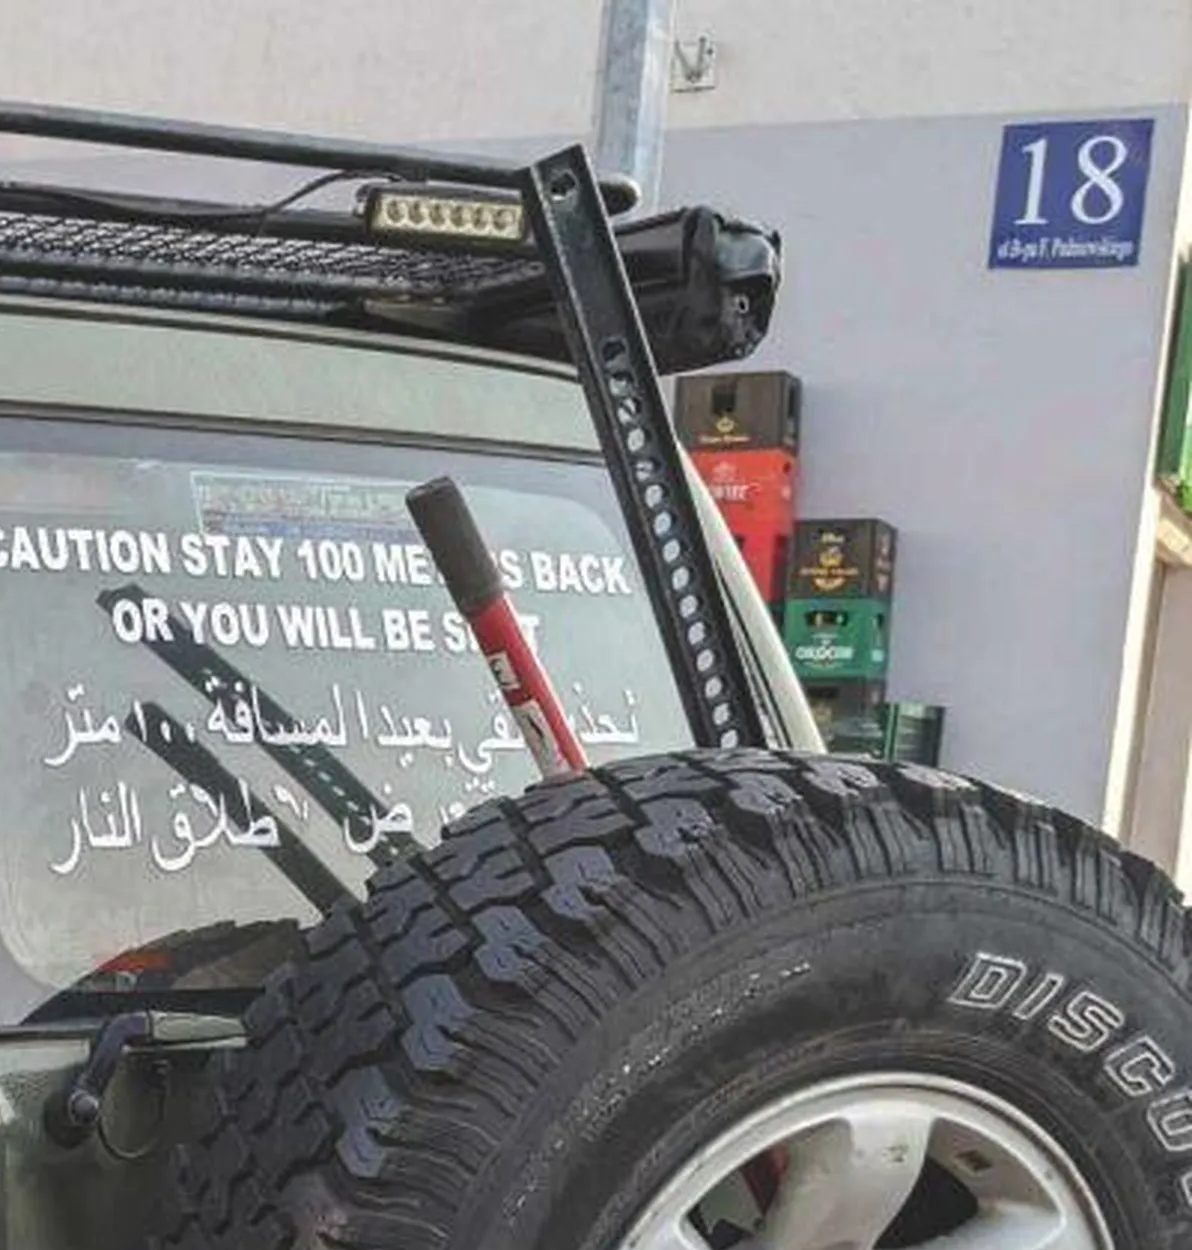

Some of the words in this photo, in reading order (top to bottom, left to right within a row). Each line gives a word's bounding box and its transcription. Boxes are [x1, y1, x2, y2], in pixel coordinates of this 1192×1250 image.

[1013, 136, 1128, 225] 18
[181, 533, 284, 578] STAY
[297, 539, 365, 581] 100
[374, 544, 524, 590] MES
[530, 551, 632, 594] BACK
[112, 598, 174, 645] OR
[179, 602, 270, 647] YOU
[275, 605, 375, 651] WILL
[382, 609, 436, 652] BE
[442, 611, 540, 656] ST
[50, 780, 141, 876] النار
